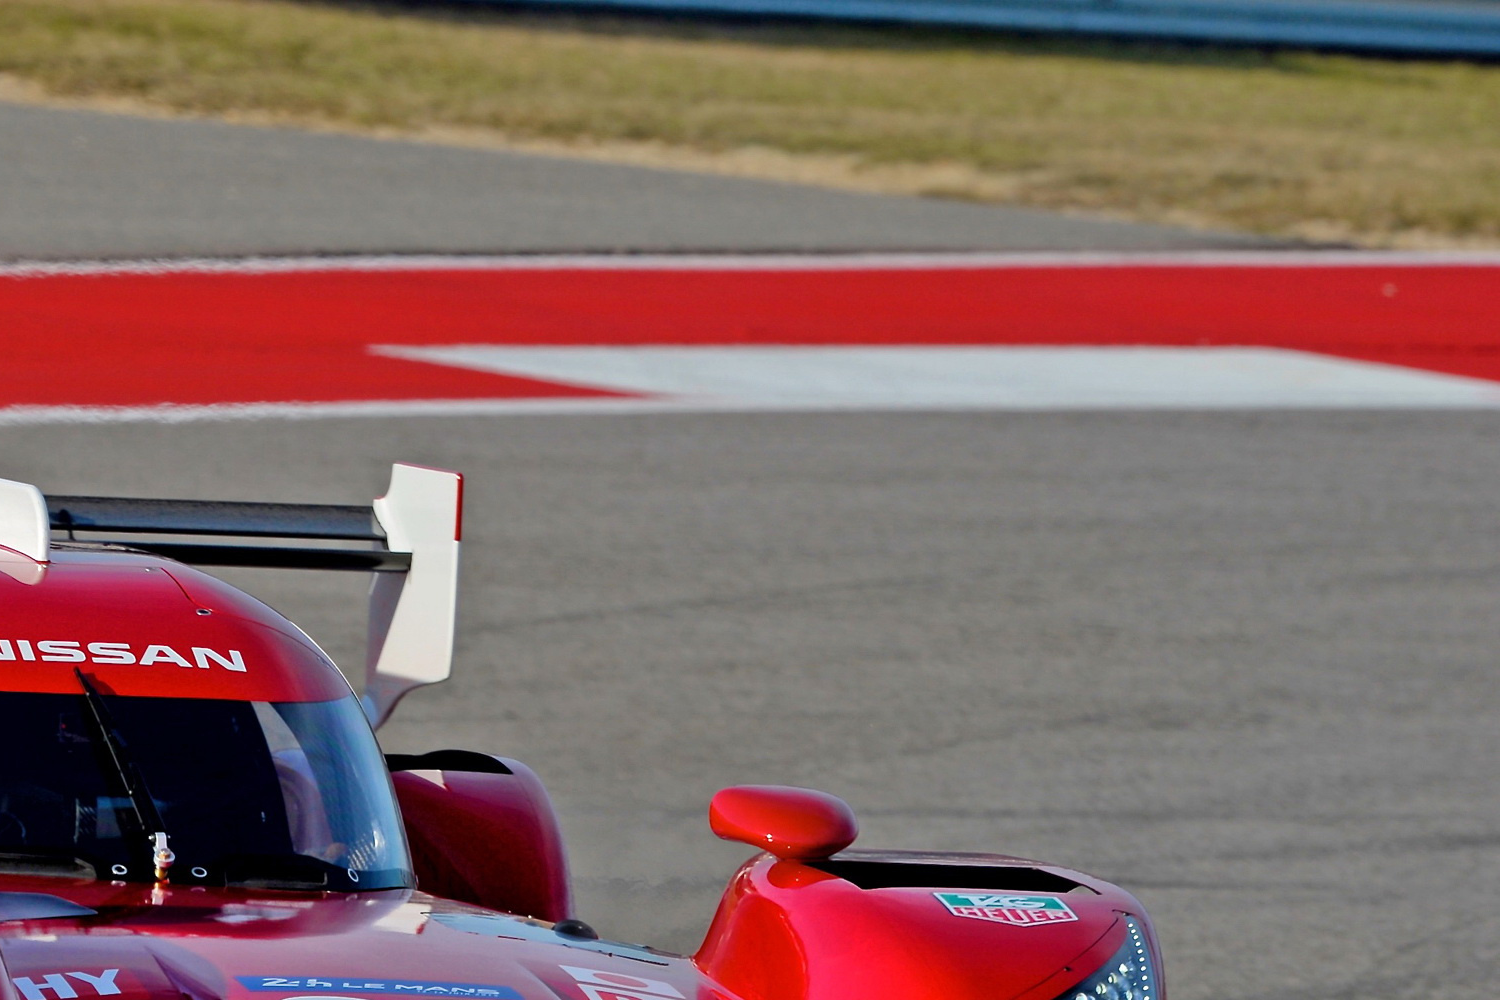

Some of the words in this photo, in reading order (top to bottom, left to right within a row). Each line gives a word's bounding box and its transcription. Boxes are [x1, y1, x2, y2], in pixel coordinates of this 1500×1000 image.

[957, 895, 1046, 908] TAG
[957, 907, 1068, 923] HEUER
[343, 982, 386, 990] LE
[394, 984, 500, 995] MANS
